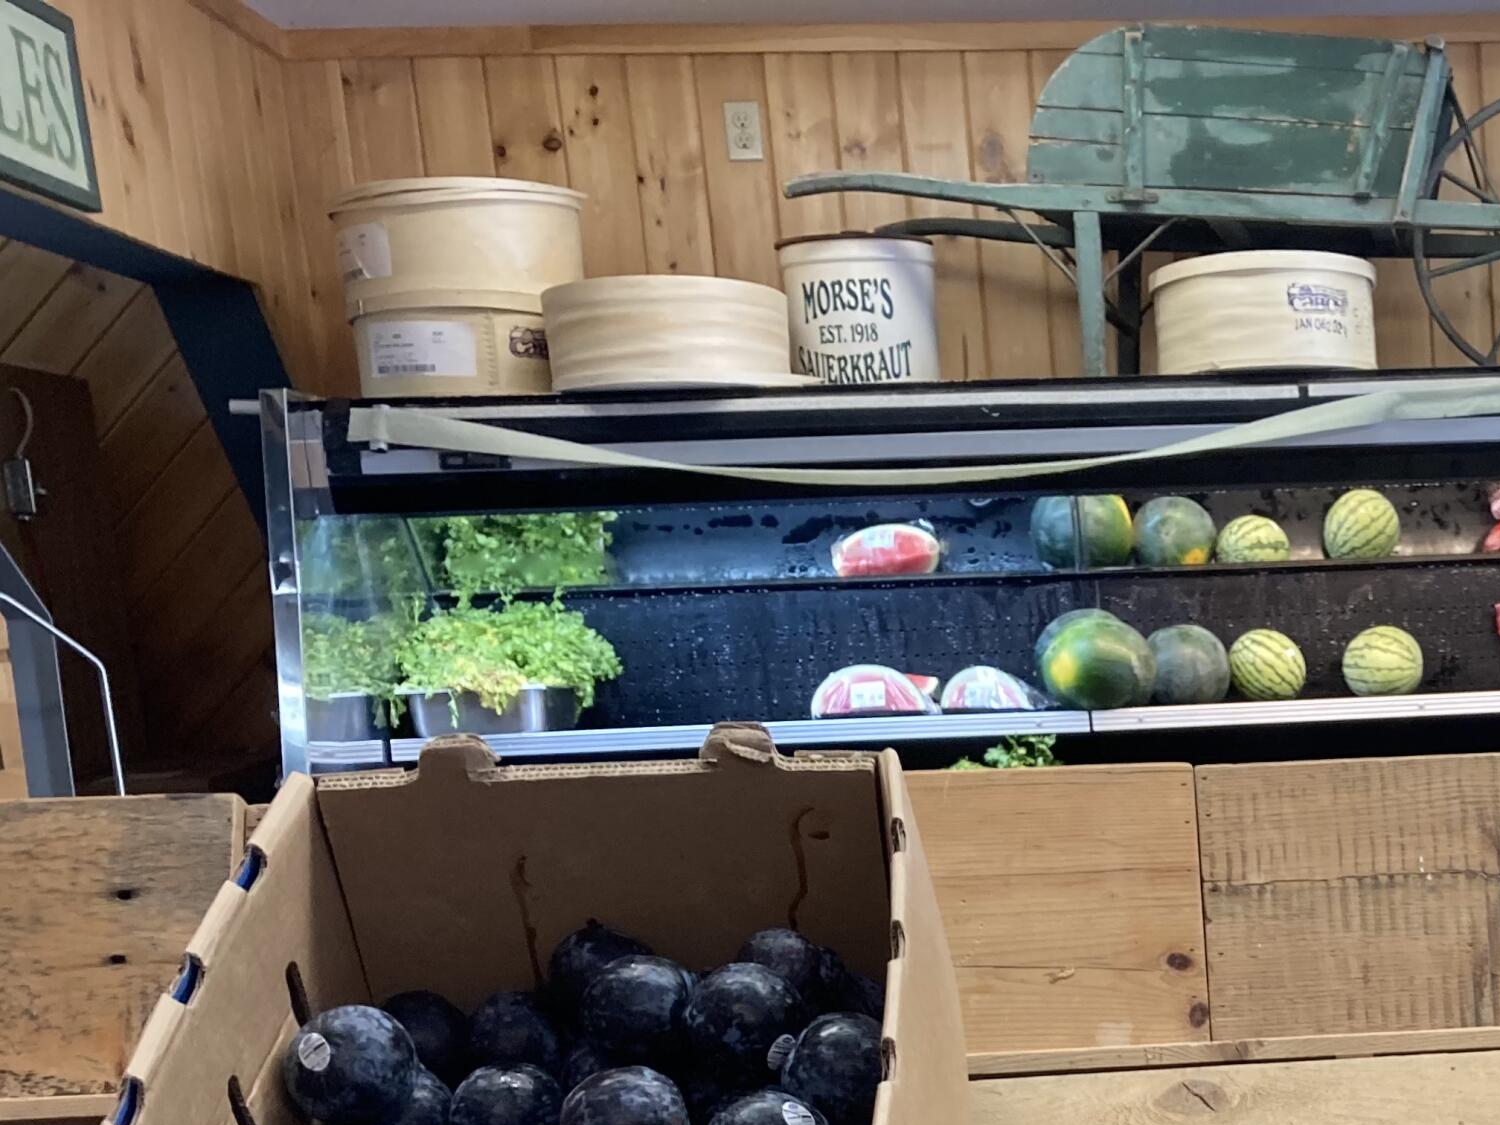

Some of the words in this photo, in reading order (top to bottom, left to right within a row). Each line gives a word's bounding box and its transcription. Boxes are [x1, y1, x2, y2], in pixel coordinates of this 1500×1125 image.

[802, 278, 894, 324] MORSE'S
[819, 325, 847, 344] EST.
[850, 323, 878, 343] 1918
[799, 340, 911, 384] SAUERKRAUT
